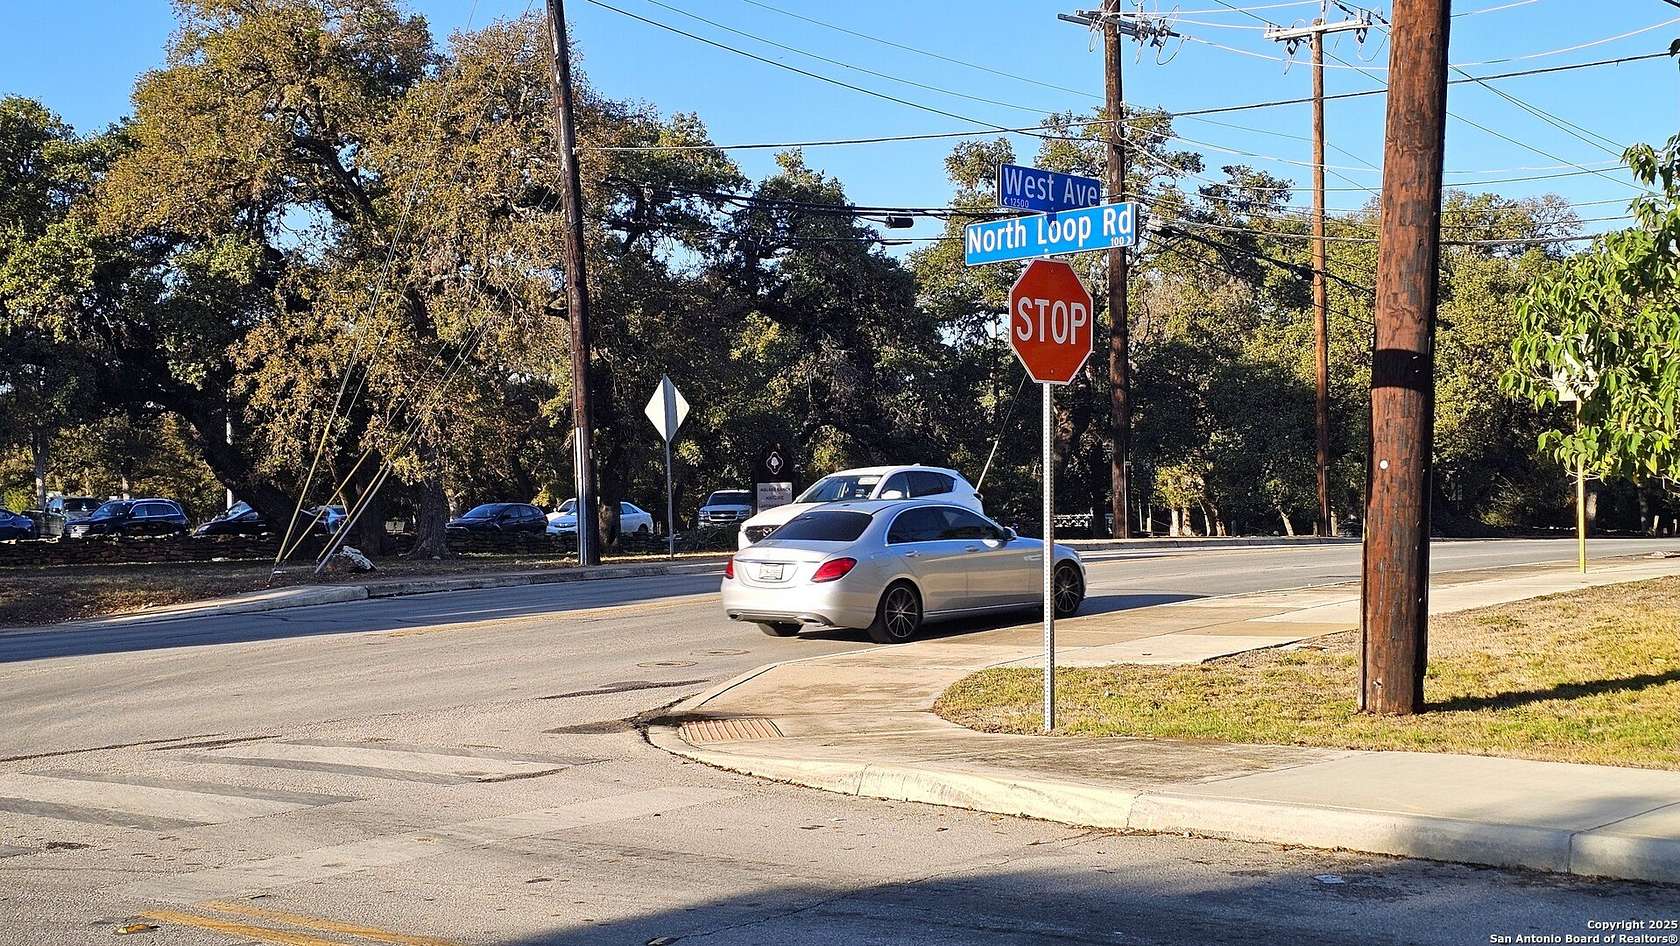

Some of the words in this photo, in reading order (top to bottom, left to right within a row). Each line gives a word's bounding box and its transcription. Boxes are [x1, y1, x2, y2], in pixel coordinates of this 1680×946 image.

[1004, 167, 1054, 202] West
[1063, 178, 1098, 207] Ave
[1010, 197, 1030, 208] 12500
[968, 218, 1027, 255] North
[1037, 215, 1091, 247] Loop
[1103, 203, 1132, 237] Rd
[1110, 236, 1125, 247] 100
[1016, 296, 1087, 345] STOP
